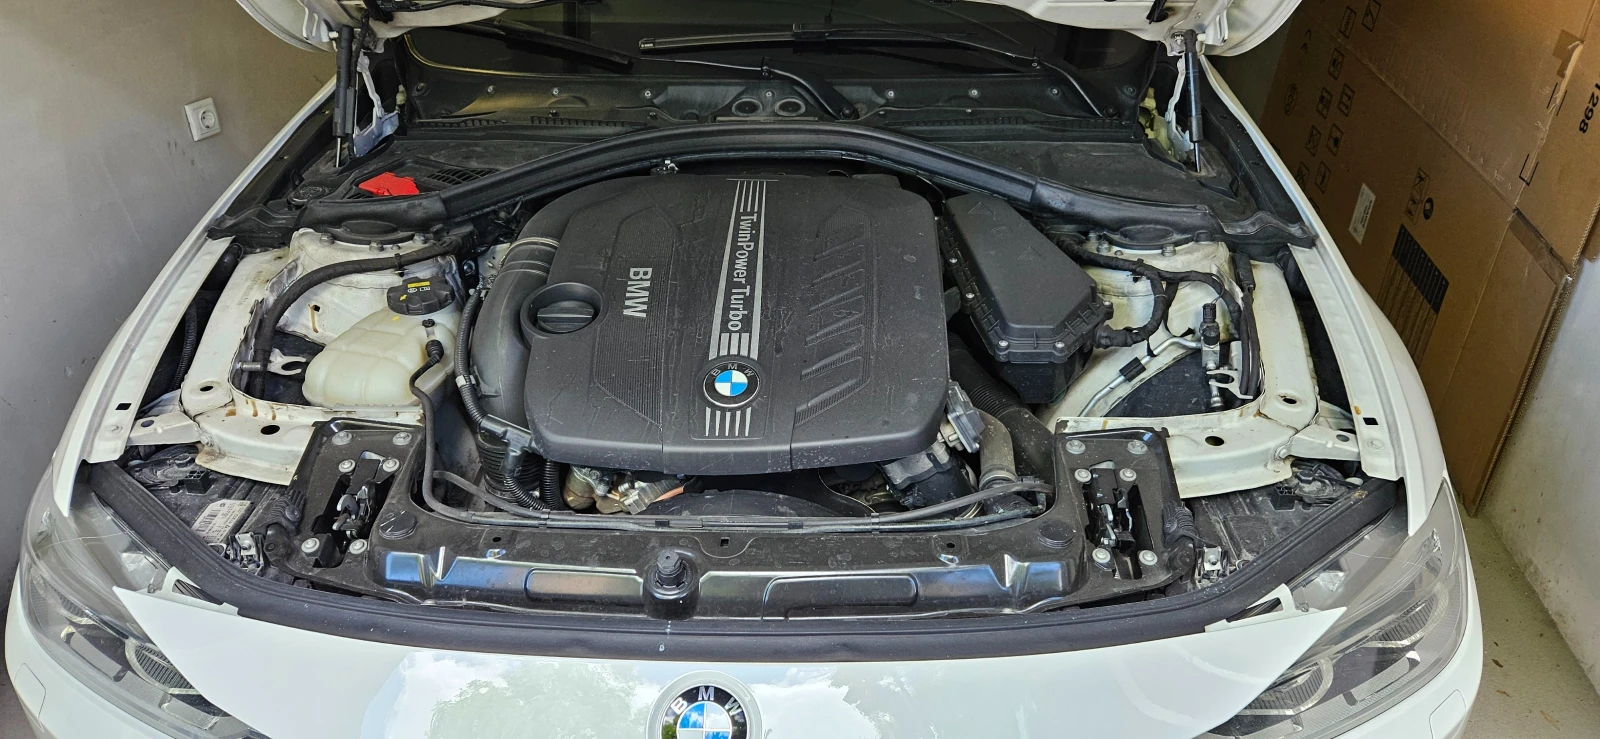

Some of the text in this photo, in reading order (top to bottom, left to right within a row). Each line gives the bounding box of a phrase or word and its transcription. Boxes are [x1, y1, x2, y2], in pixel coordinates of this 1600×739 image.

[727, 213, 758, 331] TwinPower Turbo
[622, 267, 653, 318] BMW
[710, 363, 755, 377] BMW
[670, 686, 742, 715] BMW
